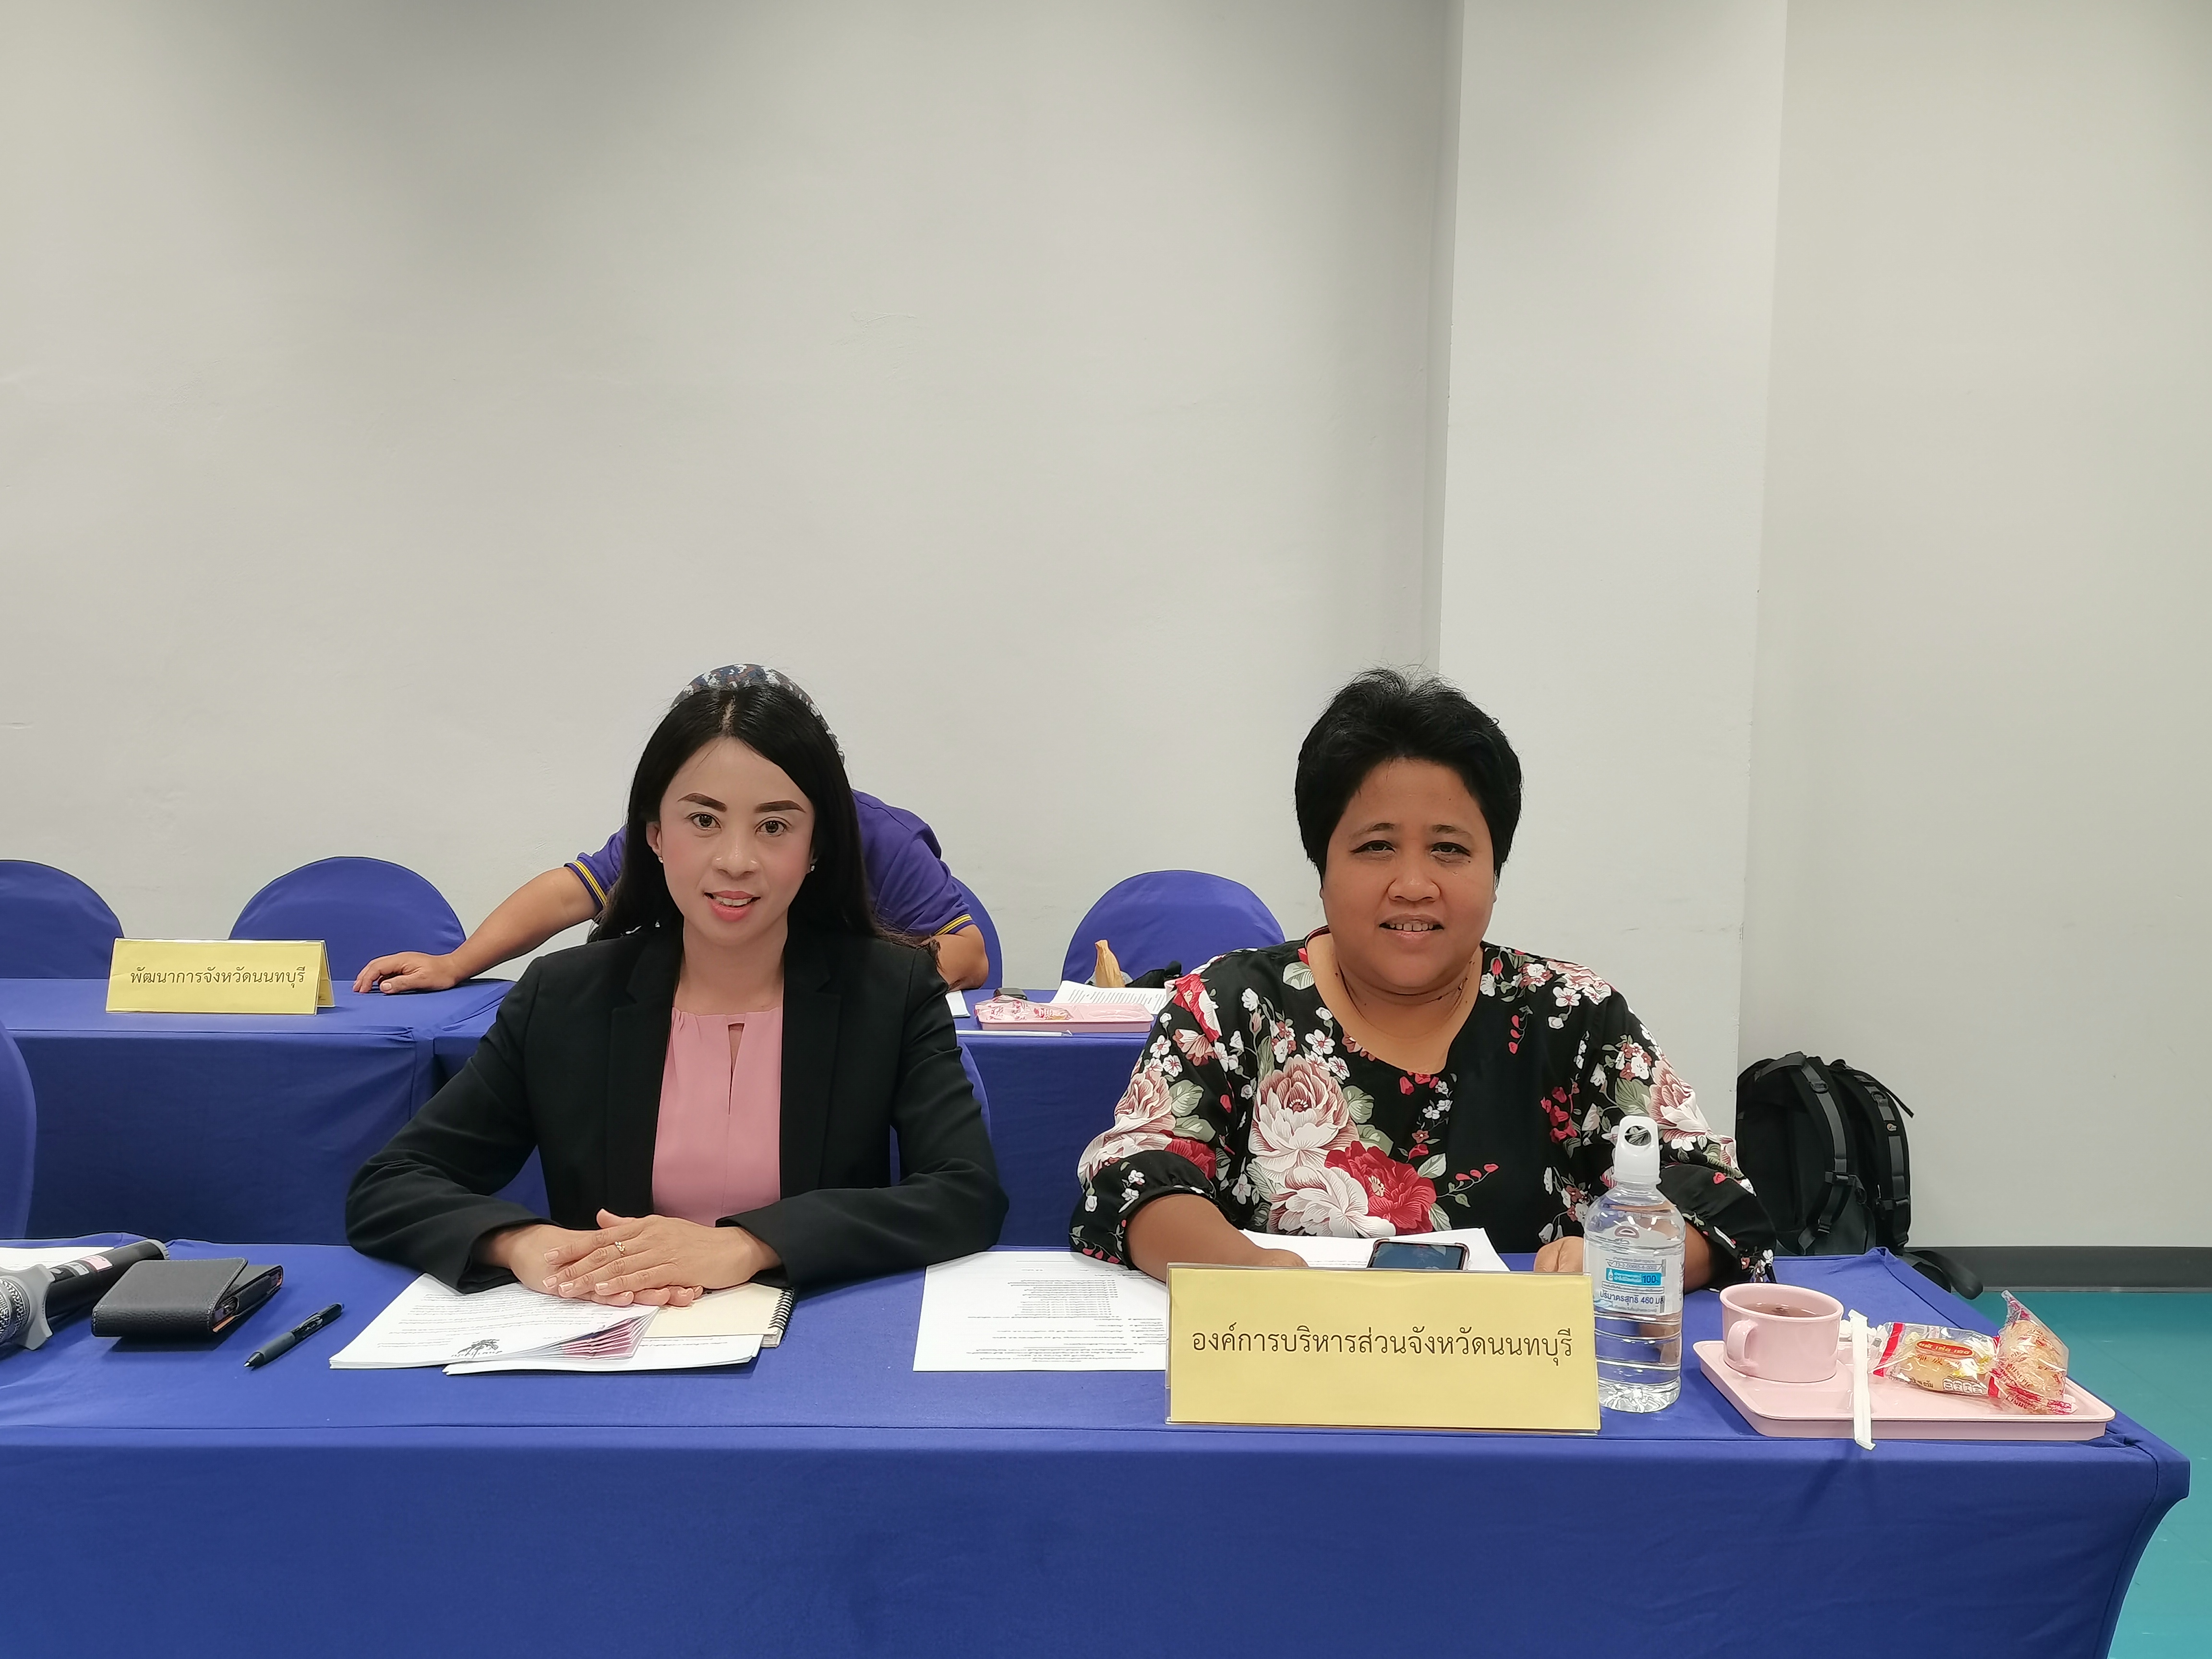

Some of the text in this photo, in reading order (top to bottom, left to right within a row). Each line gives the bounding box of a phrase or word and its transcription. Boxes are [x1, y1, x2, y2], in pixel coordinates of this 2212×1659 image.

[130, 966, 306, 988] พัฒนาการจังหวัดนนทบุรี
[1191, 1322, 1573, 1366] องค์การบริหารส่วนจังหวัดนนทบุรี
